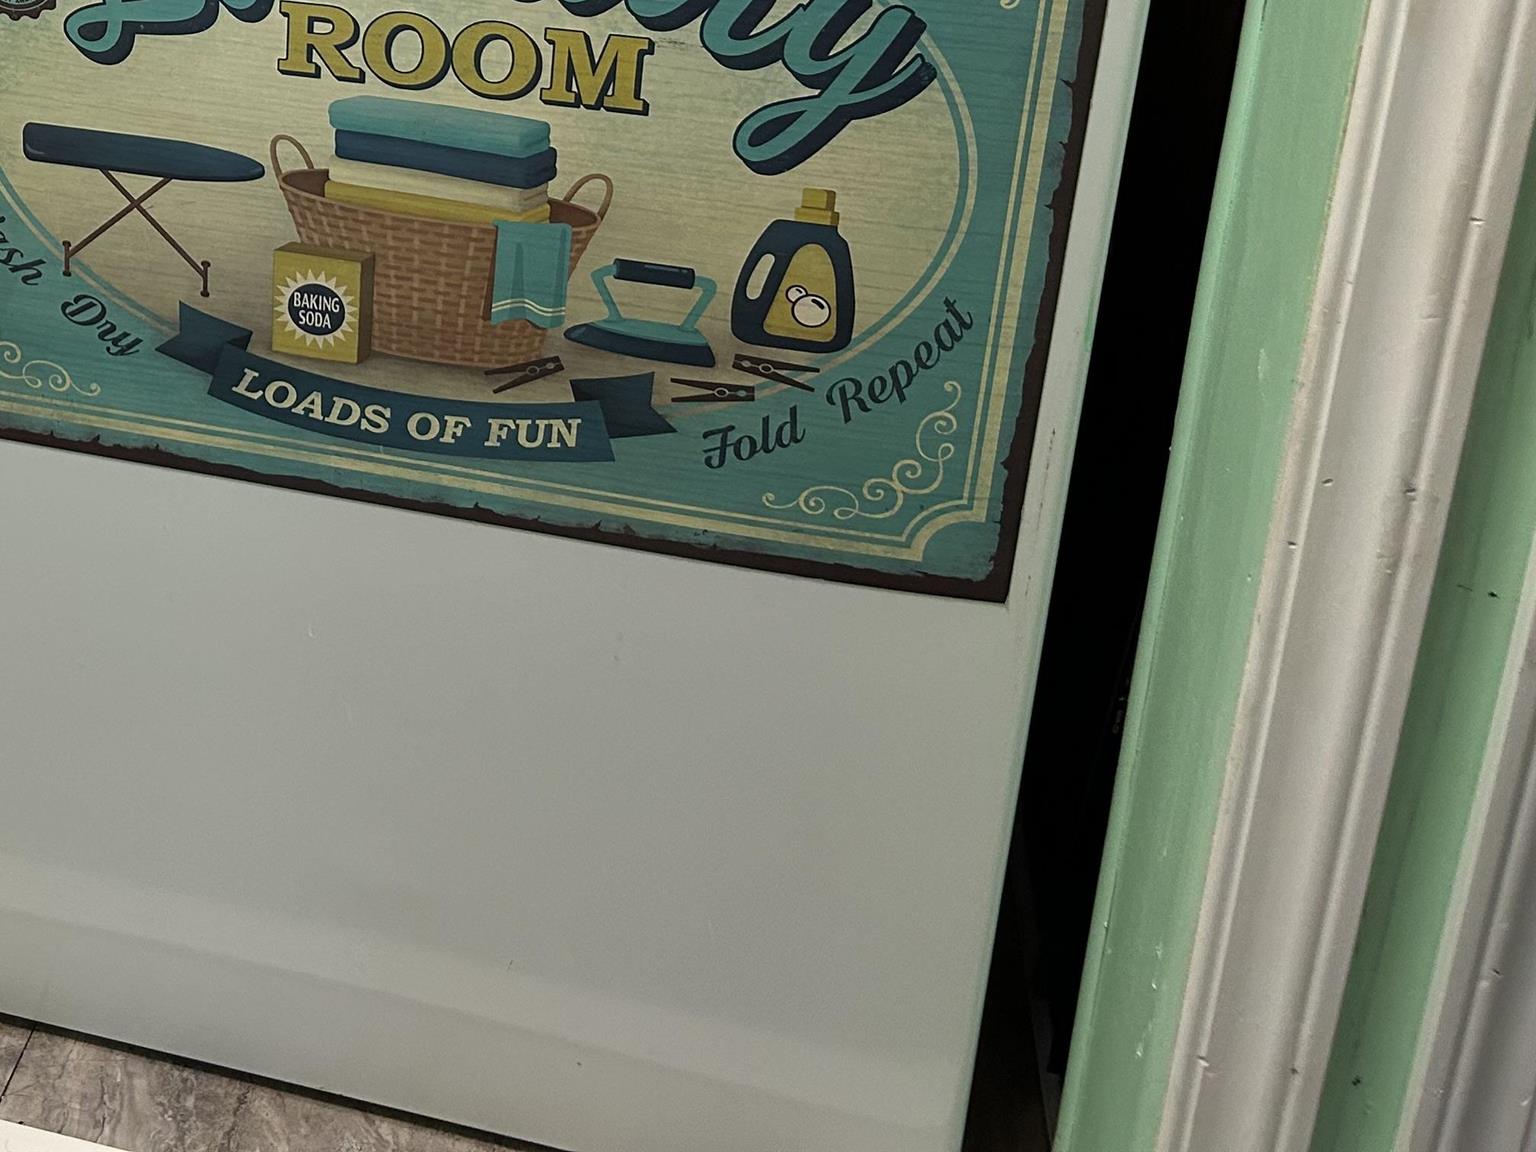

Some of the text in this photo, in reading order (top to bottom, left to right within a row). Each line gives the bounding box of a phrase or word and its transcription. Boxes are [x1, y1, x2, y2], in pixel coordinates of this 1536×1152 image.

[277, 1, 656, 116] ROOM
[60, 293, 144, 358] Dry
[293, 291, 341, 313] BAKING
[298, 309, 332, 329] SODA
[231, 368, 583, 449] LOADS OF FUN
[702, 296, 974, 470] Fold Repeat
